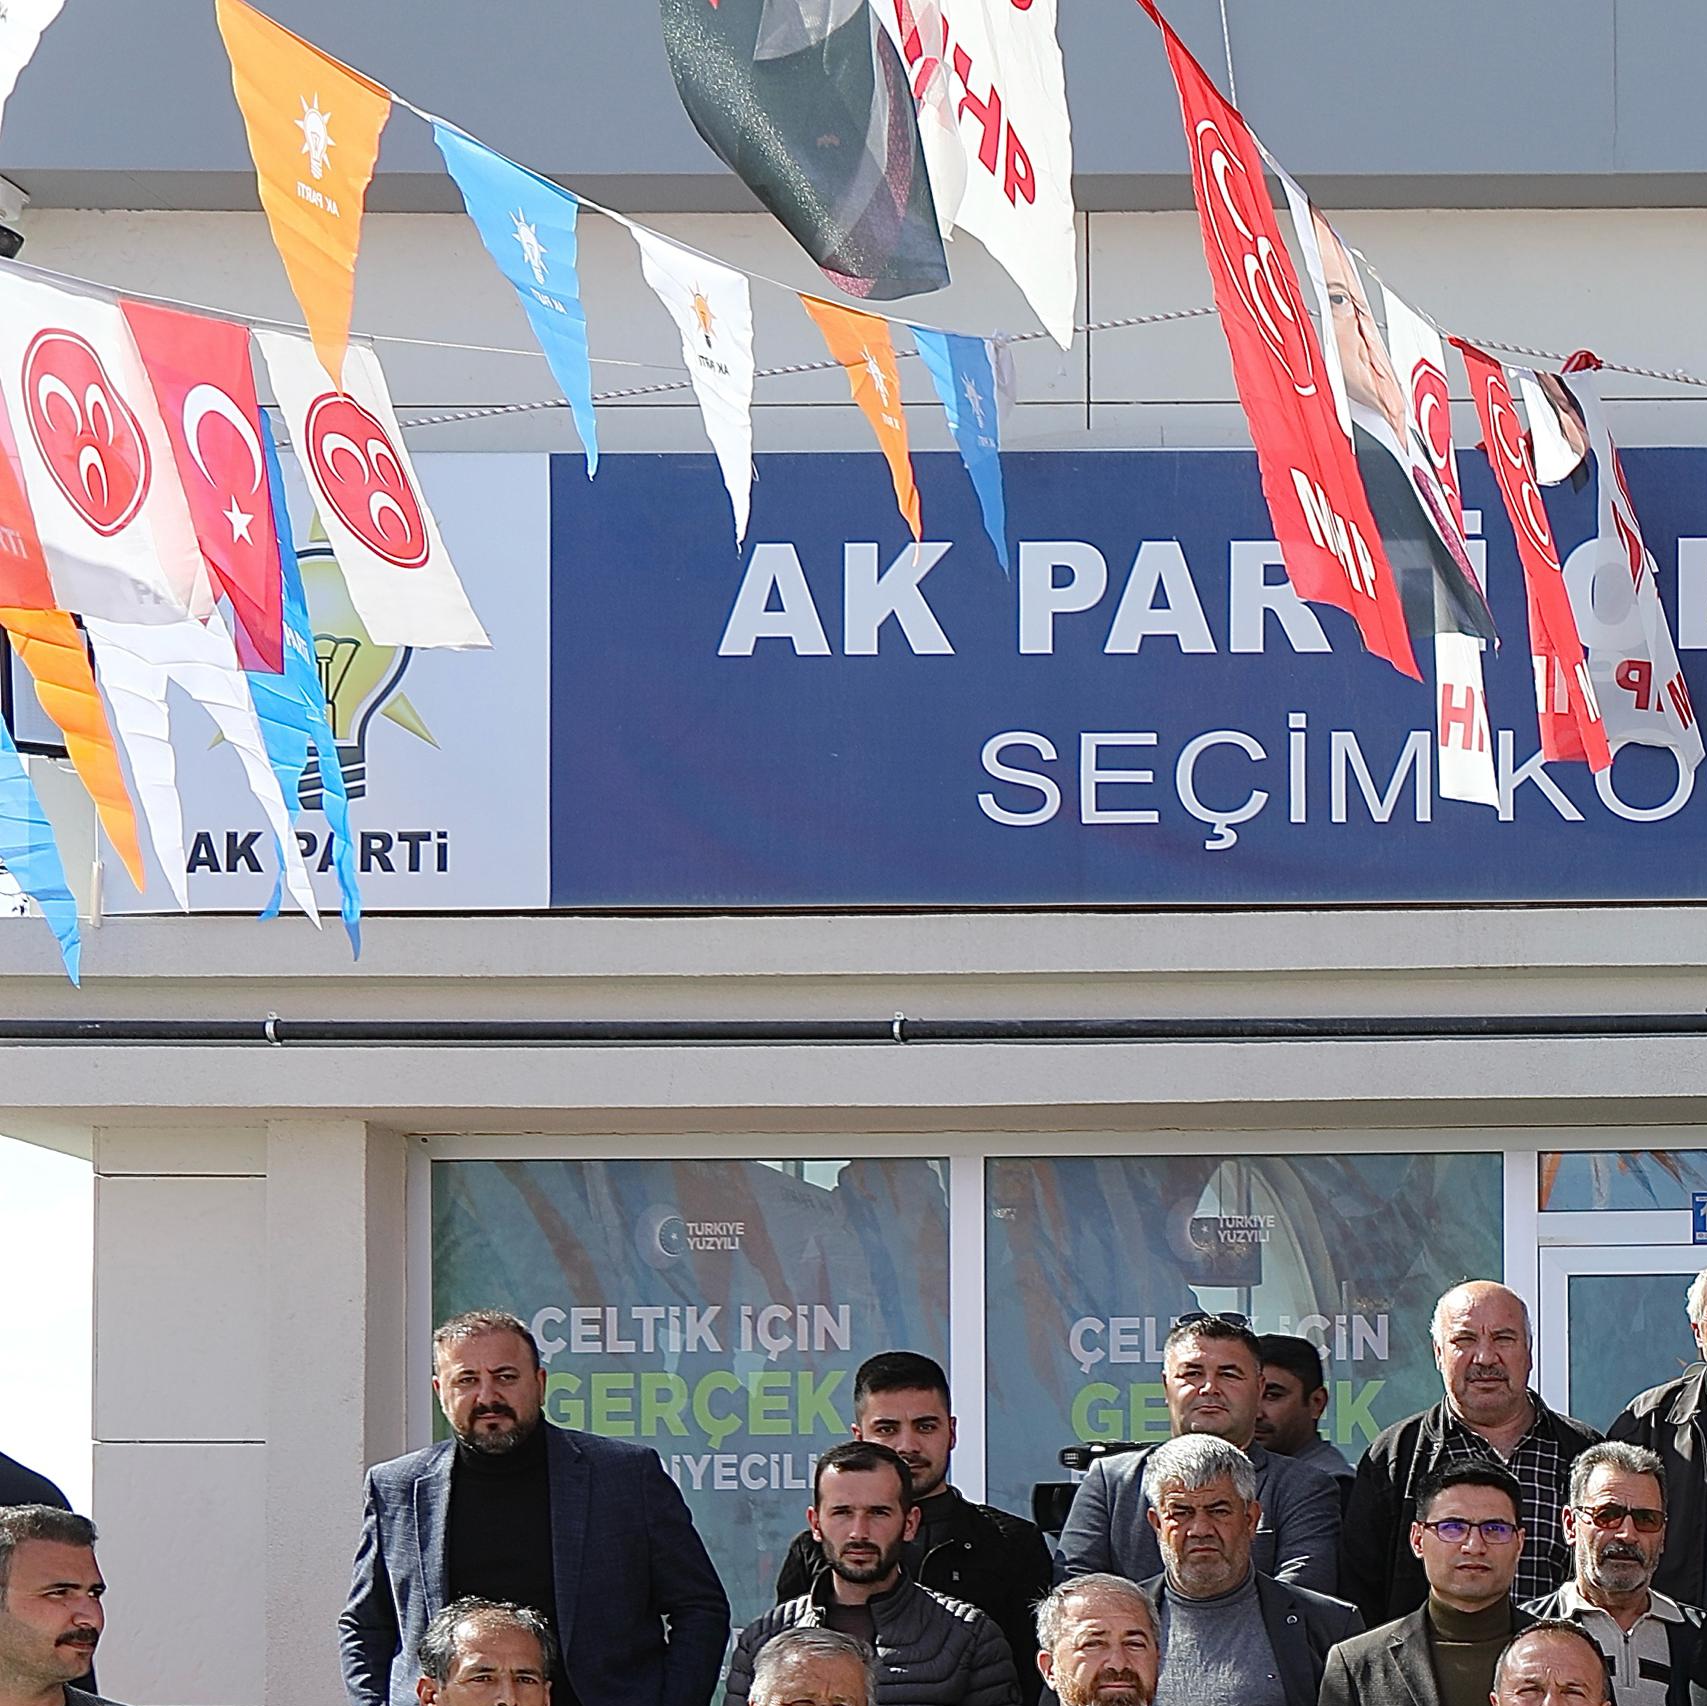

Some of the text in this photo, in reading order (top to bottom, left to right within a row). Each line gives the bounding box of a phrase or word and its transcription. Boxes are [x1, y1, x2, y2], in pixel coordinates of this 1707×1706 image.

[717, 540, 957, 657] AK
[977, 711, 1432, 850] SEÇİM
[187, 831, 265, 873] AK
[543, 1370, 849, 1450] GERÇEK
